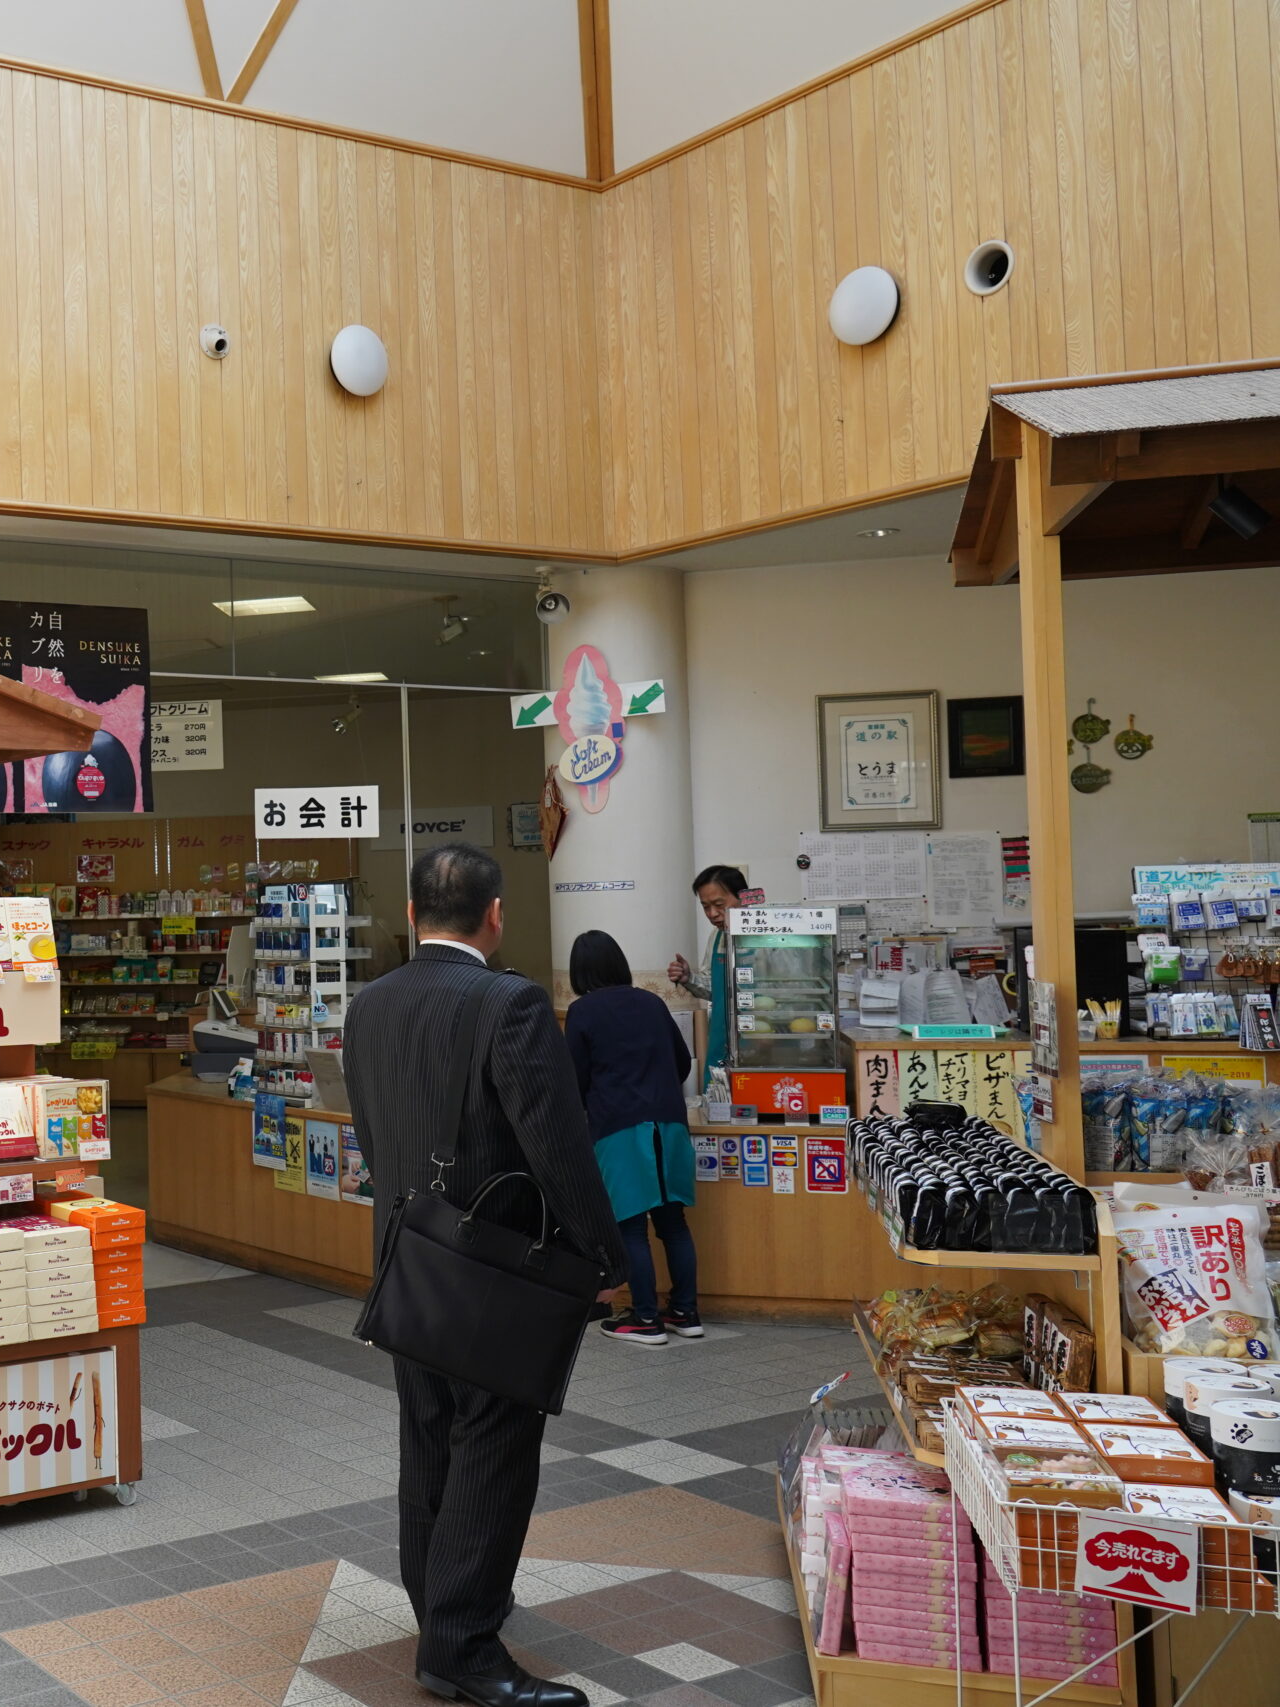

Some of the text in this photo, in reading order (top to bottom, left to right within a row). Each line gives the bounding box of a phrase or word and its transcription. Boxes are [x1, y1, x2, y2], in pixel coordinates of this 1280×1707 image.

[80, 640, 141, 653] DENSUKE
[101, 653, 141, 665] SUIKA
[184, 723, 206, 731] 270円
[856, 730, 898, 742] 道の駅
[571, 739, 599, 766] Soft
[572, 750, 612, 780] Cream
[857, 760, 897, 776] とうま
[263, 796, 368, 829] お会計
[2, 840, 52, 851] スナック
[82, 837, 145, 850] キャラメル
[177, 836, 205, 848] ガム
[11, 921, 49, 931] ほっとコーン
[810, 923, 833, 931] 140円
[983, 1053, 1009, 1120] ピザまん
[1189, 1224, 1232, 1302] 訳あり
